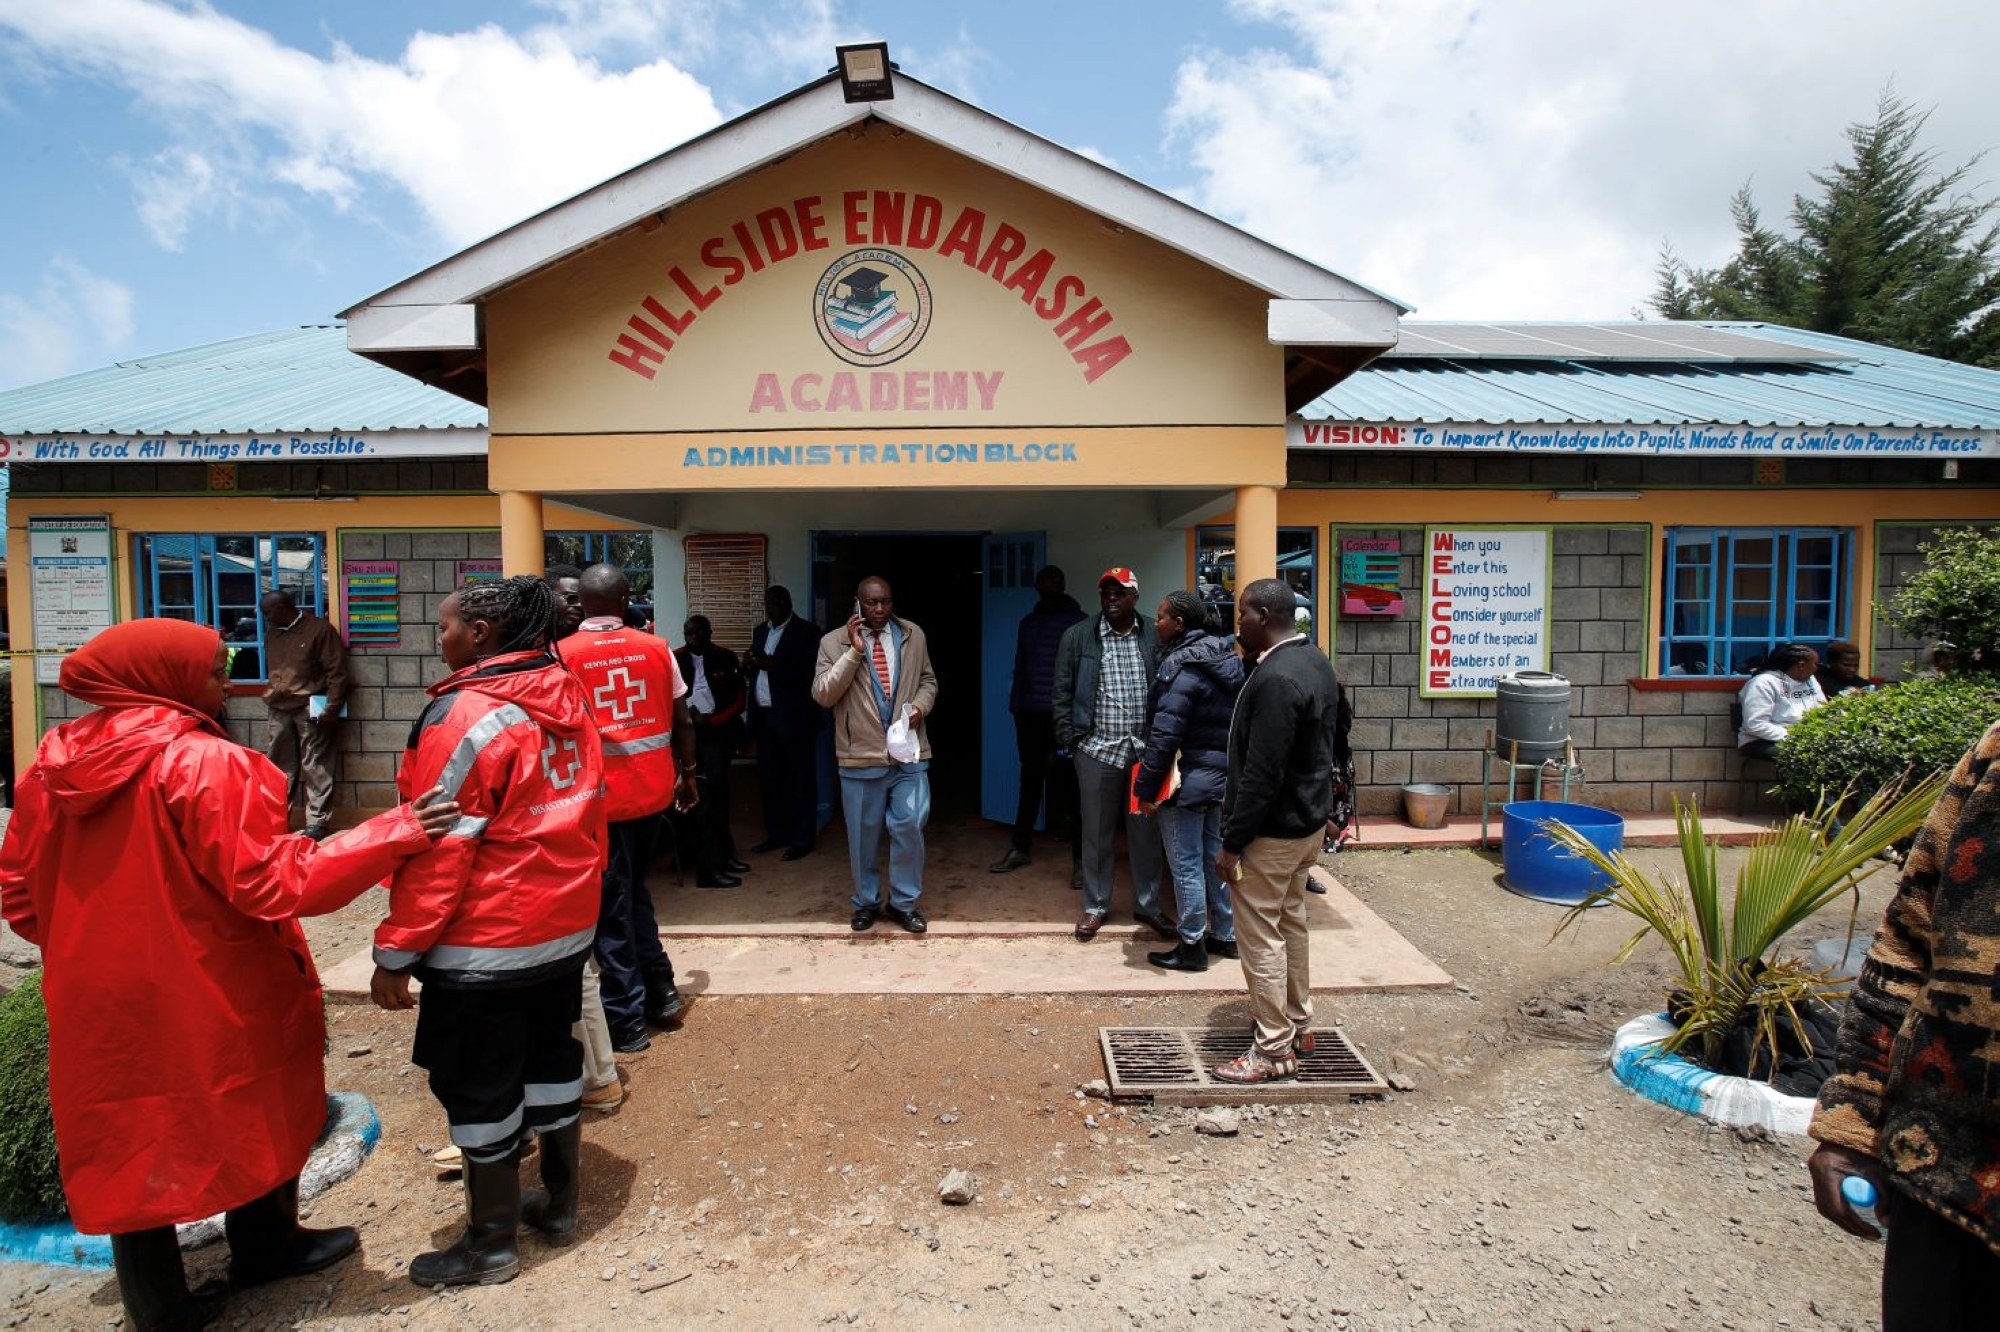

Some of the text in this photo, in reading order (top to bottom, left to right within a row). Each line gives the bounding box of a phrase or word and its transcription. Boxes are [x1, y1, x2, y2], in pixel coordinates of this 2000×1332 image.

[854, 251, 909, 271] ACADEMY
[609, 196, 829, 381] HILLSIDE
[843, 190, 1133, 384] ENDARASHA
[748, 370, 1005, 414] ACADEMY
[35, 438, 80, 459] With
[89, 439, 130, 458] God
[138, 439, 166, 458] All
[177, 436, 241, 459] Things
[245, 438, 282, 456] Are
[1302, 424, 1406, 444] VISION:
[1412, 427, 1434, 445] To
[1441, 428, 1505, 449] Impart
[1507, 429, 1600, 451] Knowledge
[1600, 430, 1636, 449] Into
[1740, 430, 1779, 450] And
[1781, 436, 1796, 450] a
[1796, 428, 1840, 451] Smile
[1842, 432, 1865, 451] On
[1865, 431, 1926, 452] Parents
[1929, 431, 1983, 452] Faces.
[682, 441, 1079, 468] ADMINISTRATION BLOCK
[1346, 540, 1390, 552] Calendar
[1434, 533, 1501, 556] When you
[1433, 555, 1508, 574] Enter this
[1432, 578, 1531, 602] Loving school
[1432, 601, 1543, 626] Consider yourself
[1430, 625, 1538, 647] One of the special
[584, 657, 608, 669] KENYA
[623, 654, 646, 663] CROSS
[1430, 649, 1530, 668] Members of an
[1429, 670, 1475, 689] Extra
[529, 797, 571, 816] DISASTER
